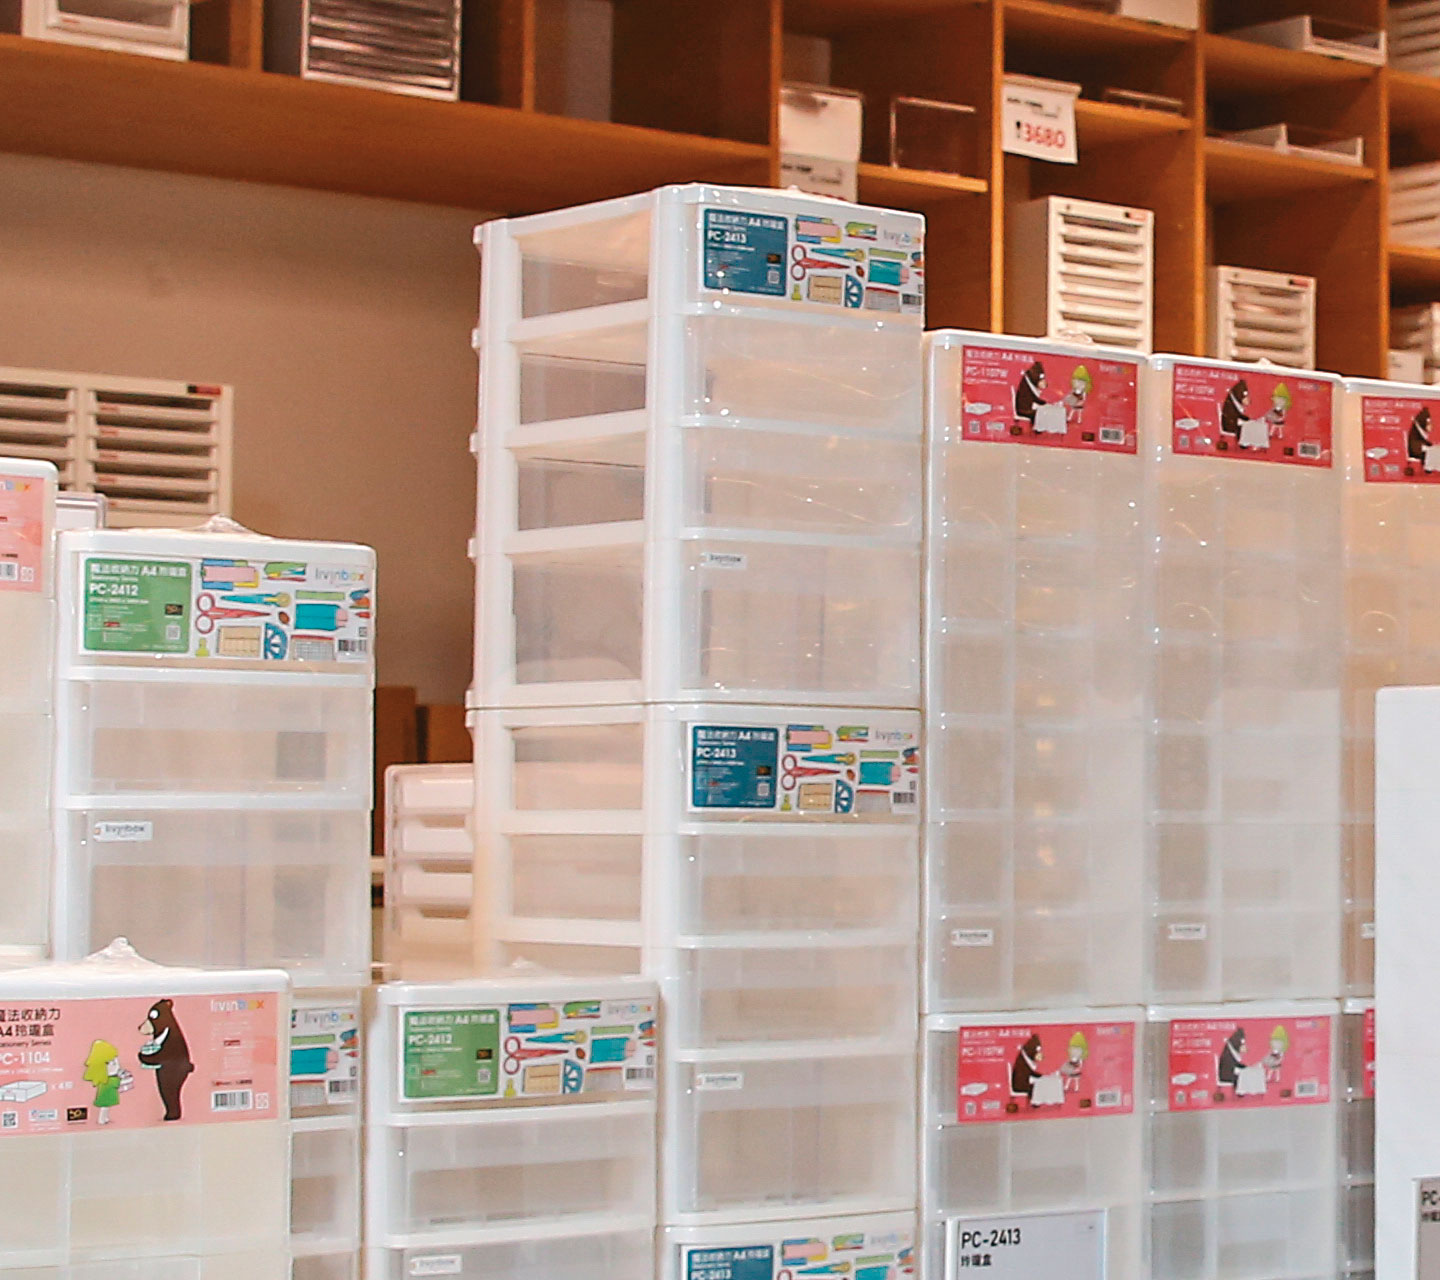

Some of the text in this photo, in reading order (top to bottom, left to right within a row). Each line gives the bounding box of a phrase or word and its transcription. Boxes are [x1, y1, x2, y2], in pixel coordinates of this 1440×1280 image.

[708, 230, 747, 243] PC-2413
[89, 583, 139, 596] PC-2412
[696, 747, 736, 758] PC-2413
[409, 1034, 452, 1045] PC-2412
[961, 1228, 1021, 1250] PC-2413
